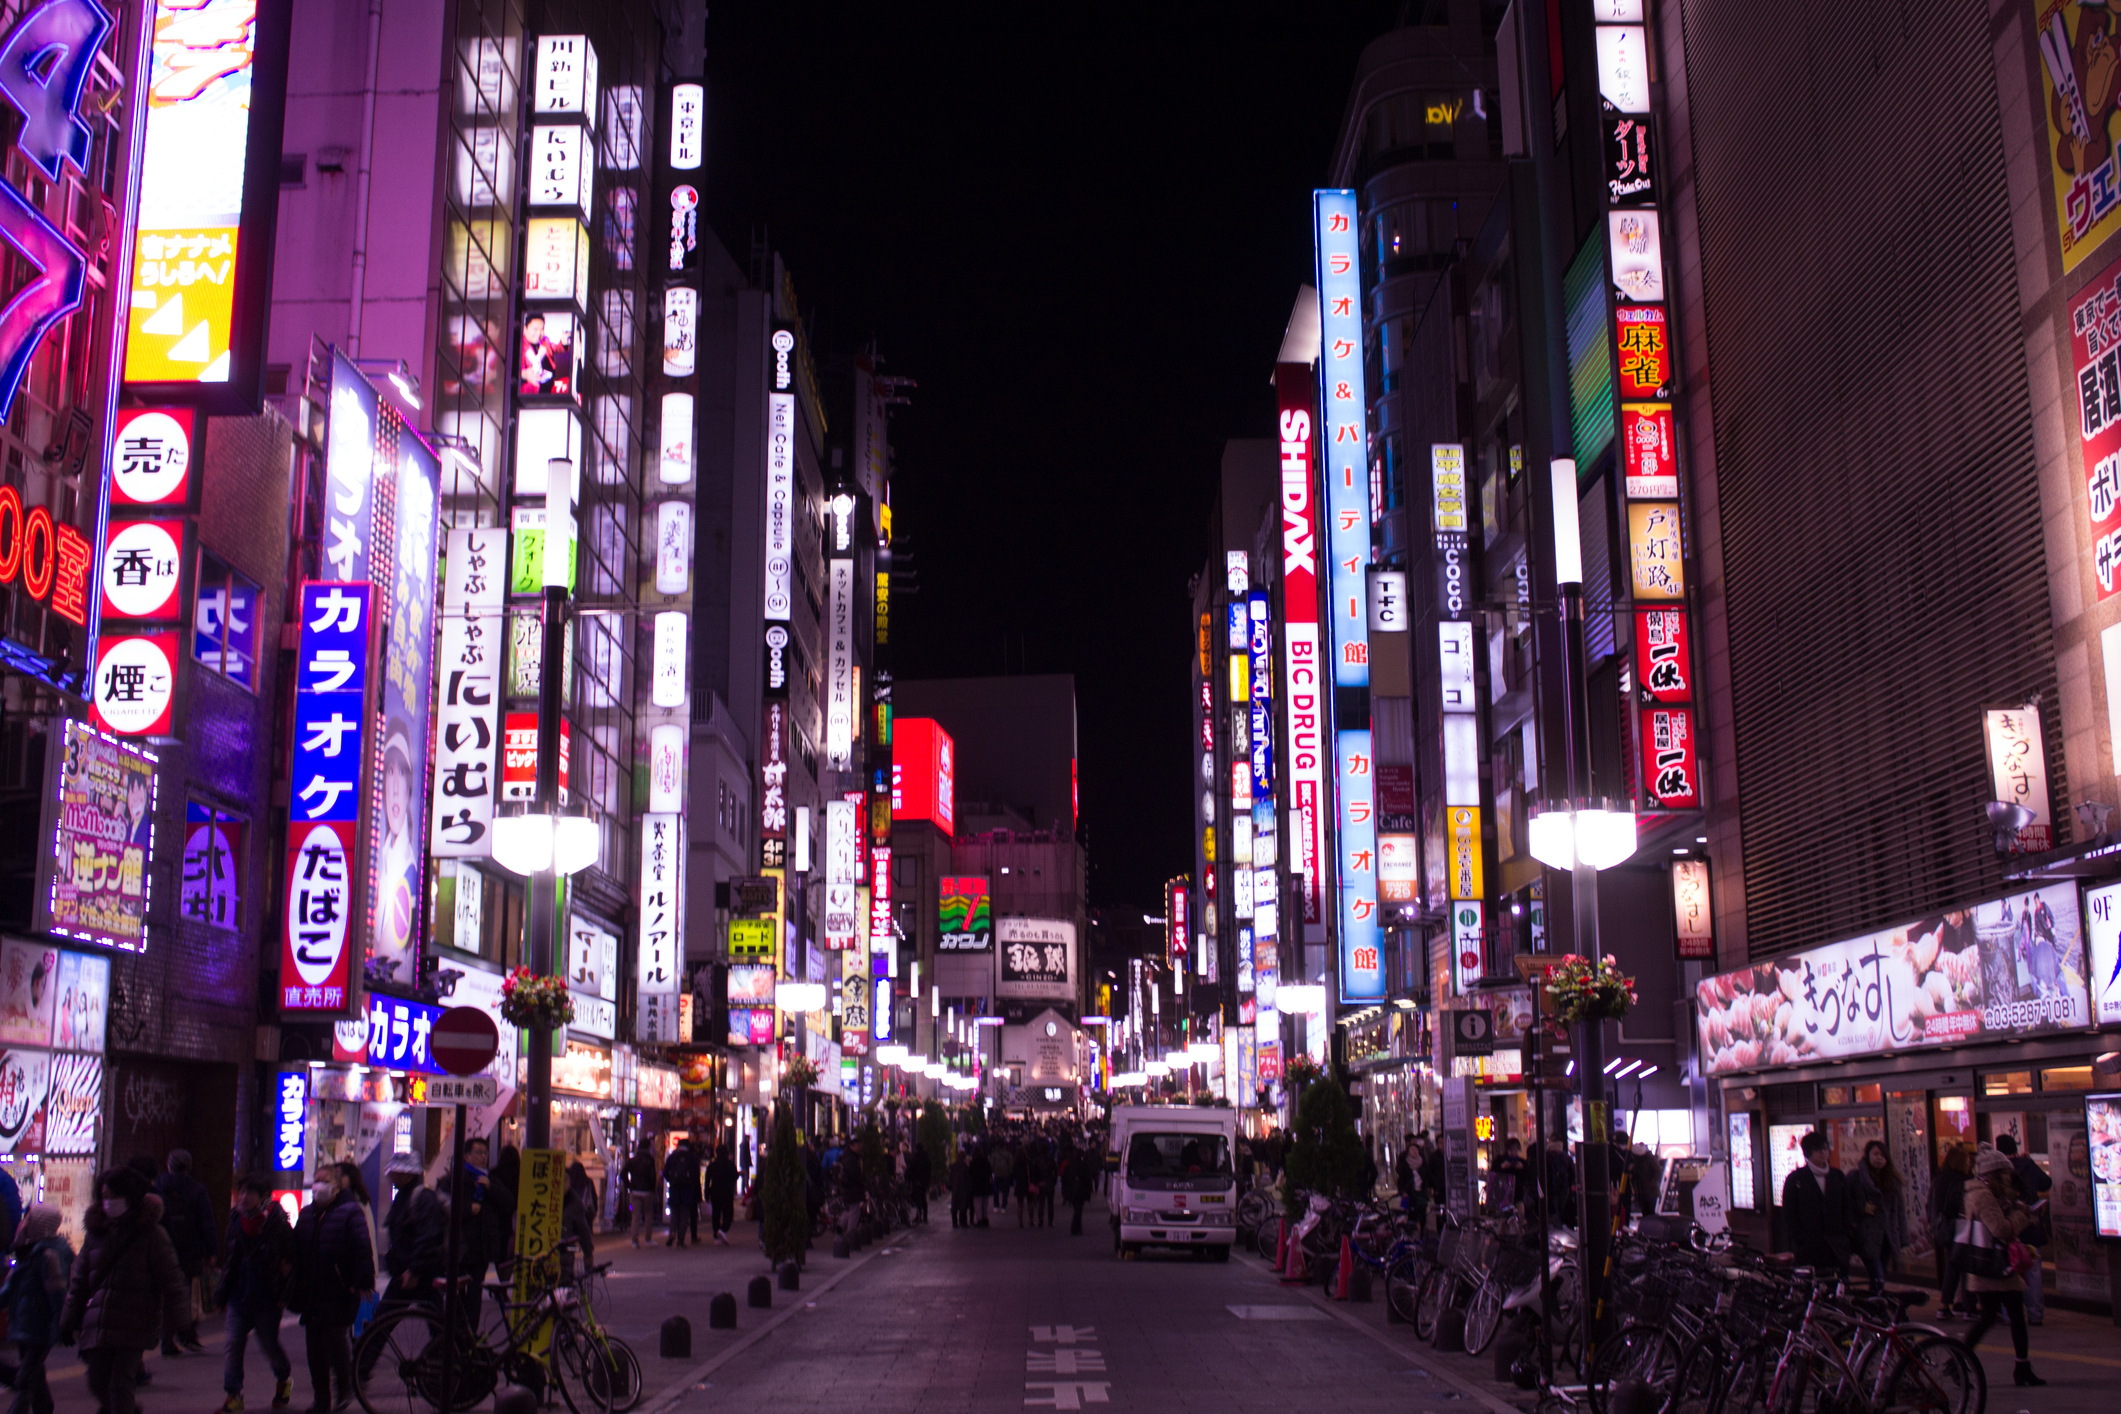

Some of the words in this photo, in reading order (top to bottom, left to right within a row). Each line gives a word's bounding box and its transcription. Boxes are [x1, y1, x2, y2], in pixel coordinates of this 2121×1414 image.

[679, 101, 696, 160] 東京ビル
[1613, 119, 1636, 180] ダーツ
[544, 130, 567, 201] にいむら
[1616, 308, 1665, 323] ウェルカム
[2086, 307, 2121, 361] 旨くて
[772, 329, 795, 390] Booth
[1619, 323, 1663, 388] 麻雀
[776, 403, 788, 428] Net
[1656, 387, 1670, 400] 6F
[2078, 340, 2121, 442] 居酒
[122, 437, 164, 474] 売
[771, 490, 786, 551] Capsule
[1279, 408, 1315, 577] SHIDAX
[113, 548, 153, 586] 香
[1645, 508, 1672, 588] 戸灯路
[1446, 549, 1463, 612] COCO
[104, 664, 147, 703] 煙
[765, 625, 789, 690] Booth
[1291, 641, 1314, 686] BIC
[298, 588, 362, 820] カラオケ
[1292, 694, 1318, 771] DRUG
[441, 669, 492, 846] にいむら
[1300, 783, 1312, 805] BIC
[1379, 814, 1413, 830] Cafe
[652, 820, 667, 882] 喫茶室
[763, 838, 784, 854] 4F
[1346, 752, 1378, 973] カラオケ館
[1383, 861, 1413, 869] EXCHANGE
[296, 843, 342, 966] たばこ
[1385, 887, 1411, 899] 729
[1386, 880, 1411, 889] BRAND
[1679, 861, 1702, 936] きづなすし
[2092, 894, 2114, 925] 9F
[646, 891, 669, 984] ルノアール
[284, 986, 344, 1009] 直売所
[1802, 938, 1912, 1043] きづなすし
[1993, 997, 2078, 1027] 03-5287-1081
[370, 1000, 434, 1065] カラオ
[430, 1079, 492, 1099] 自転車を除く
[279, 1075, 306, 1170] カラオケ
